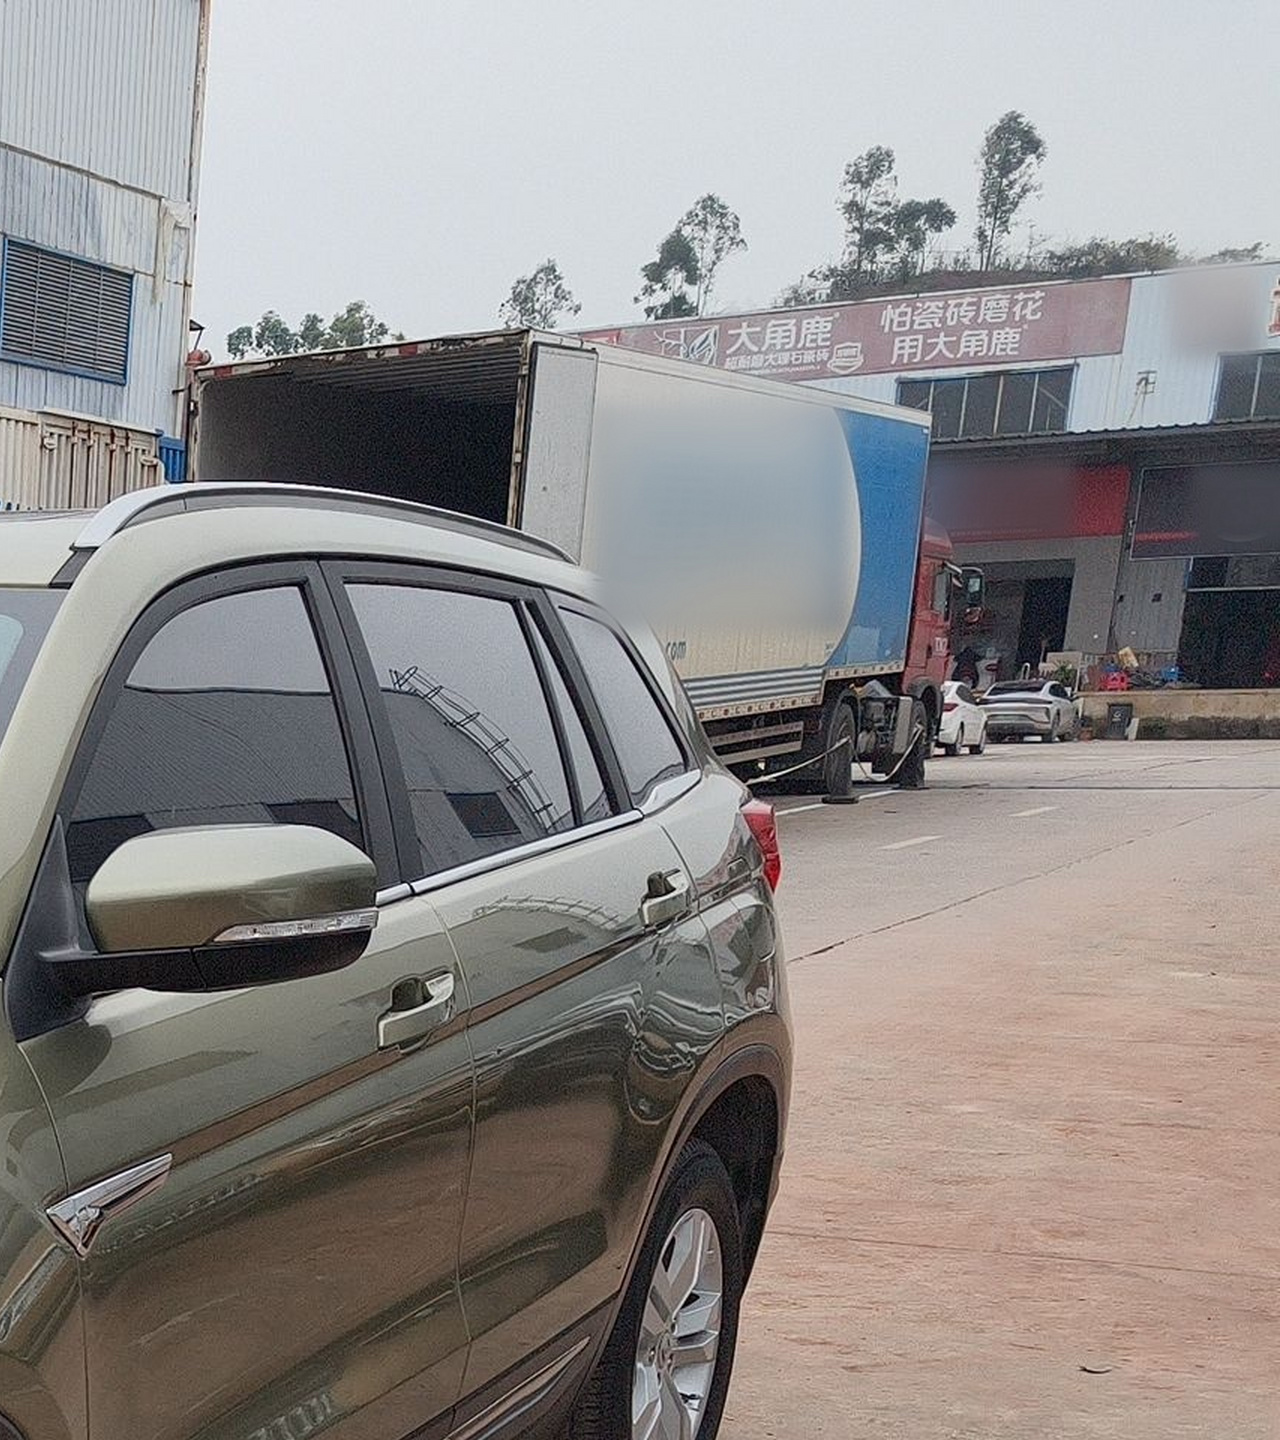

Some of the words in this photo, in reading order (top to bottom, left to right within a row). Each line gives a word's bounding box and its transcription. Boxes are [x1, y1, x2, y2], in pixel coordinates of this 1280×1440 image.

[880, 290, 1046, 333] 怕瓷砖磨花
[726, 314, 834, 354] 大角鹿
[891, 326, 1023, 365] 用大角鹿
